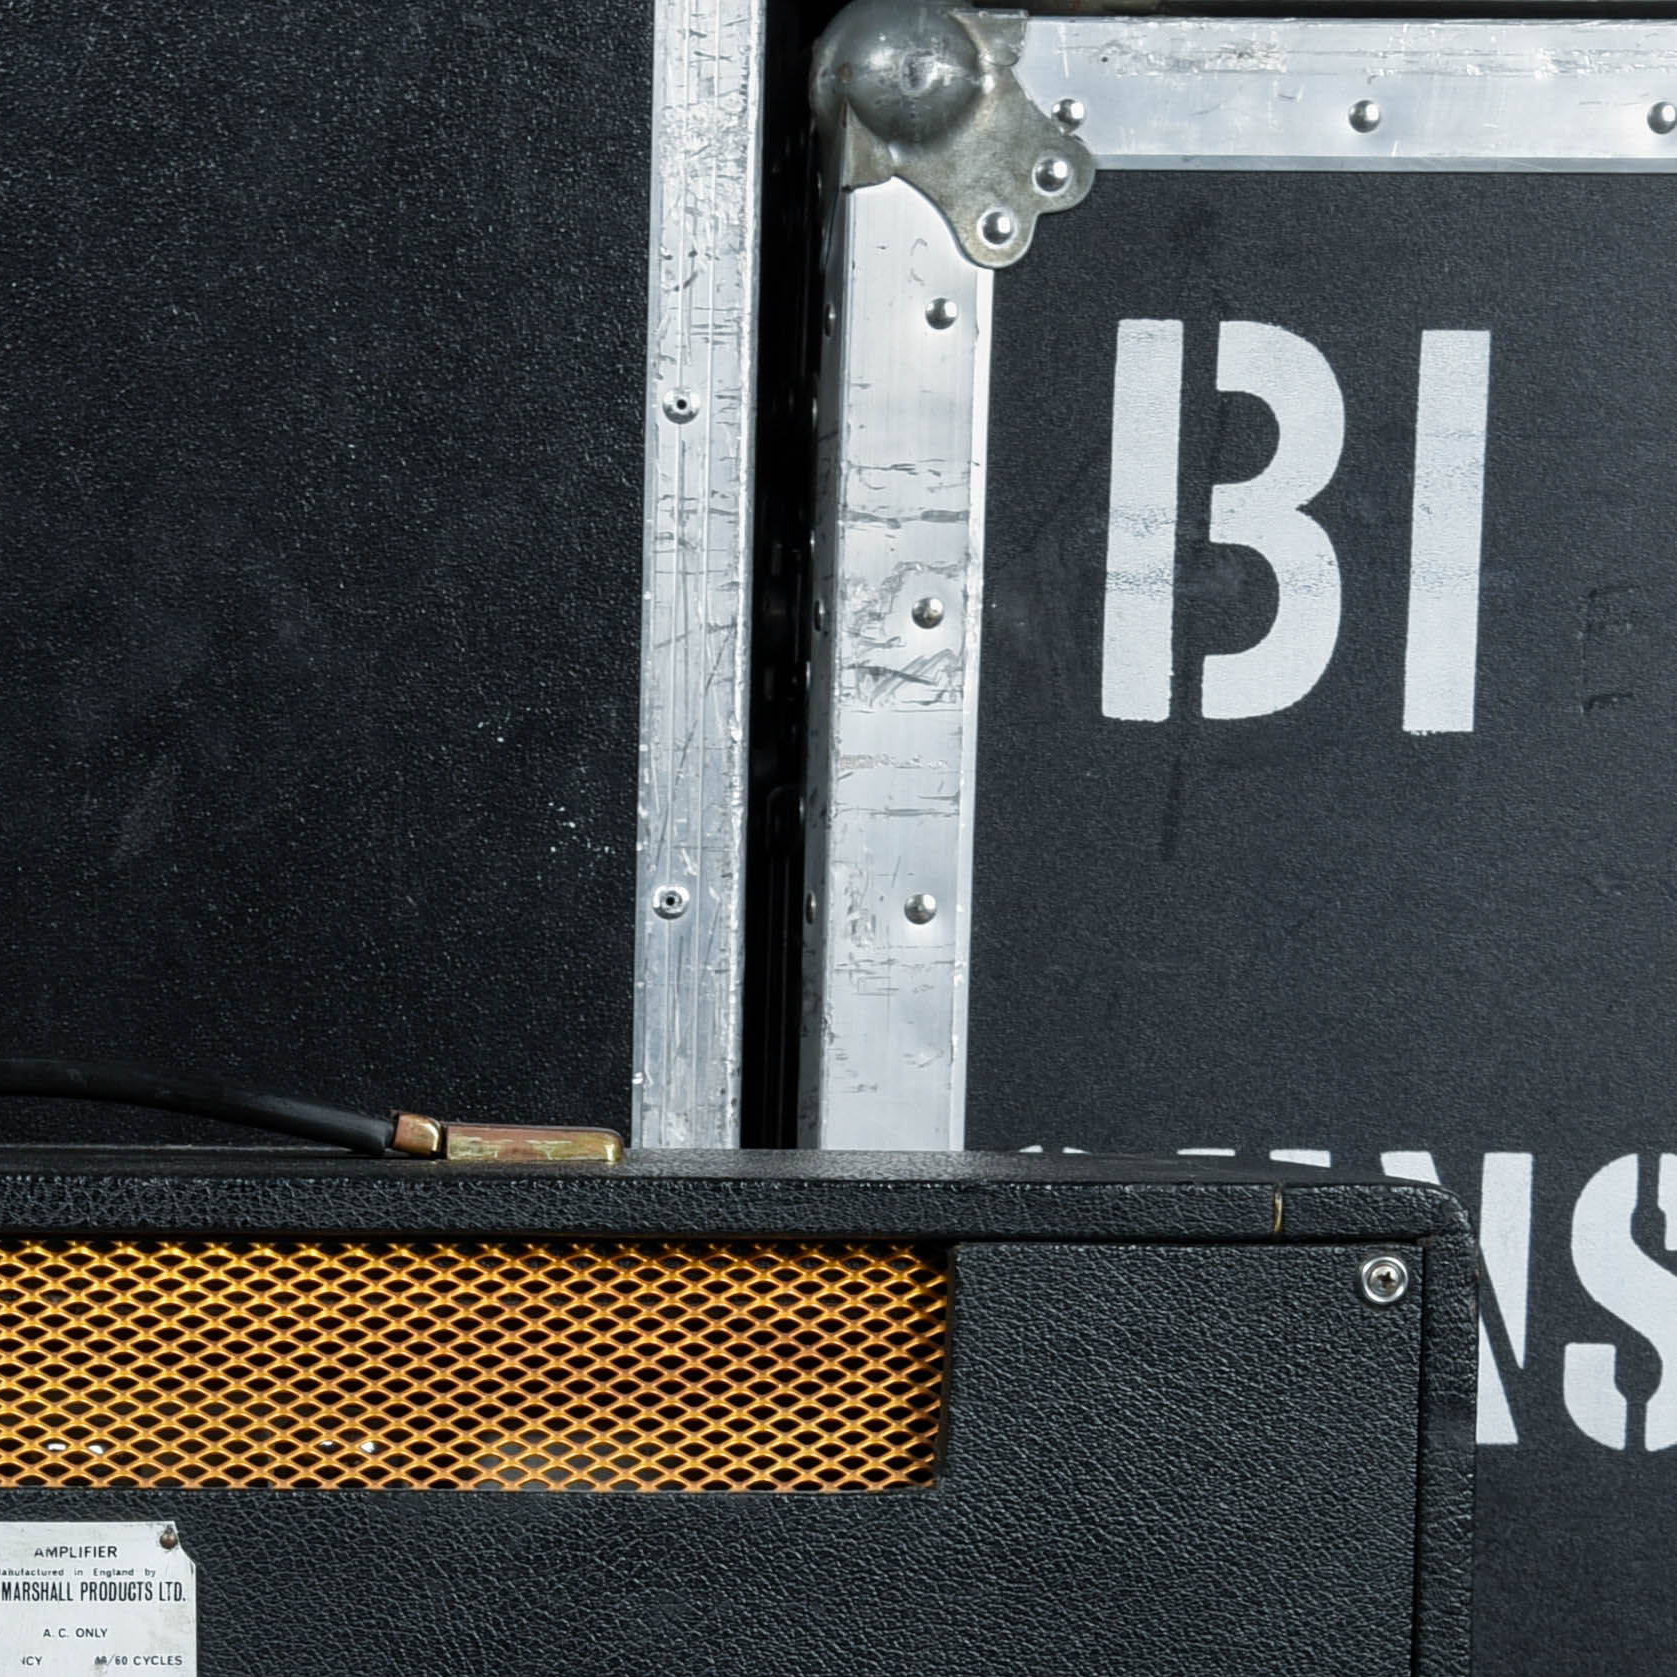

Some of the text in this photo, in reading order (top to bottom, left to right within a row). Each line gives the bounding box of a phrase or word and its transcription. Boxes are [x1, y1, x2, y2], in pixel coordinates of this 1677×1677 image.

[34, 1546, 118, 1558] AMPLIFIER
[74, 1567, 83, 1577] in
[93, 1568, 134, 1578] England
[145, 1568, 156, 1578] by
[1, 1581, 73, 1601] MARSHALL
[80, 1581, 153, 1601] PRODUCTS
[159, 1581, 186, 1601] LTD.
[75, 1628, 108, 1638] ONLY
[133, 1655, 183, 1666] CYCLES
